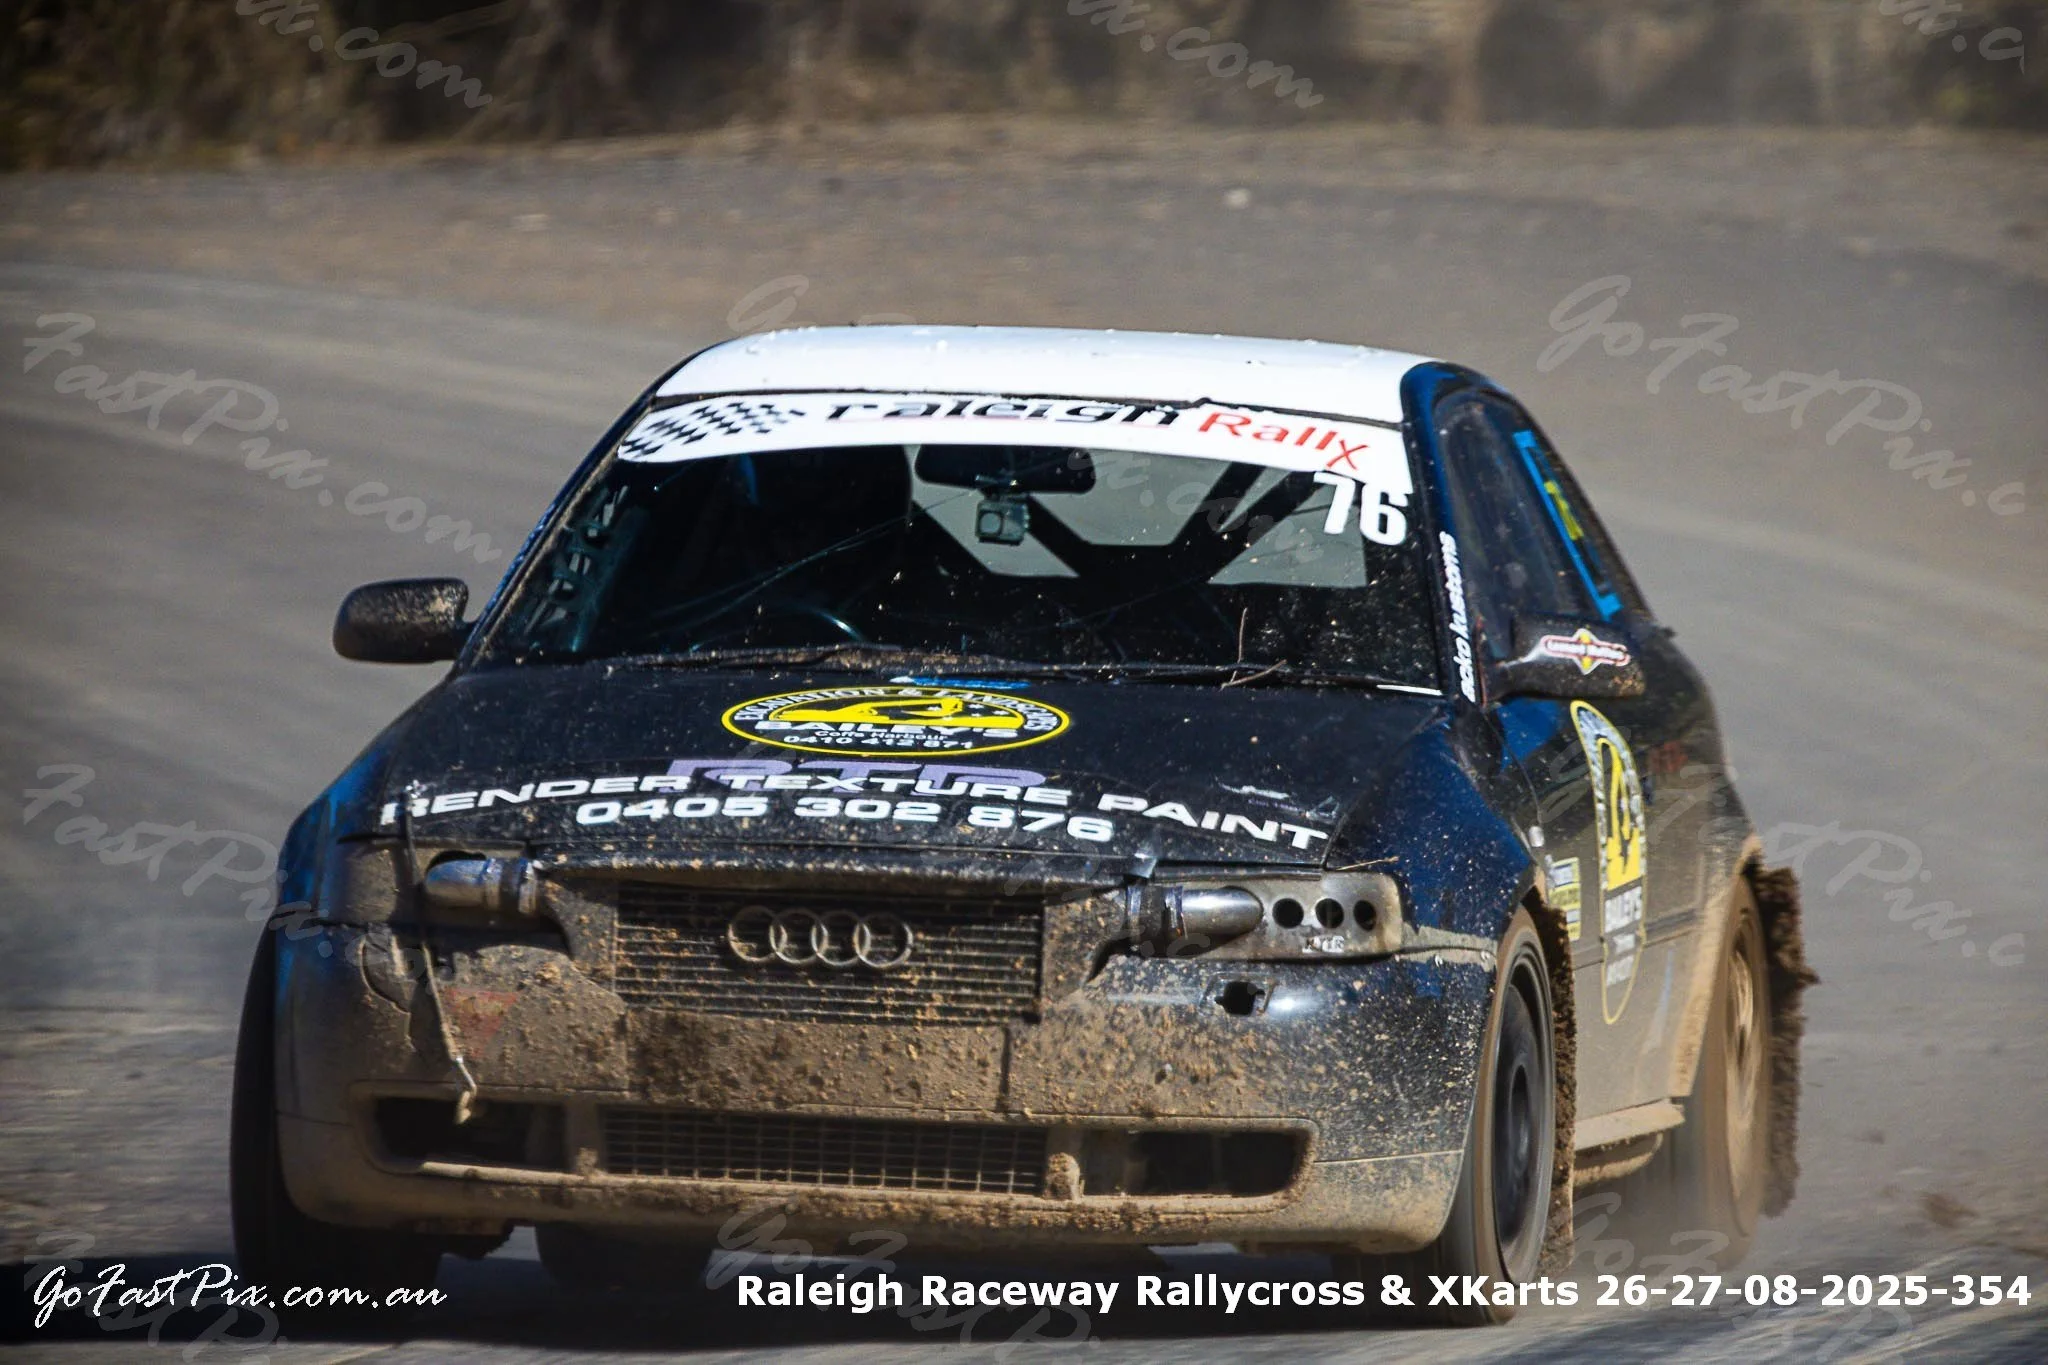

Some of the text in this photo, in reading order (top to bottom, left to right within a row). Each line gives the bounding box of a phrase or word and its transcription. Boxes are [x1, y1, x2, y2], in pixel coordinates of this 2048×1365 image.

[1313, 471, 1409, 546] 76
[754, 720, 1018, 738] BAILEY'S
[783, 735, 853, 744] 0410
[379, 774, 1329, 850] RENDER TEXTURE PAINT
[575, 796, 1115, 843] 0405 302 876
